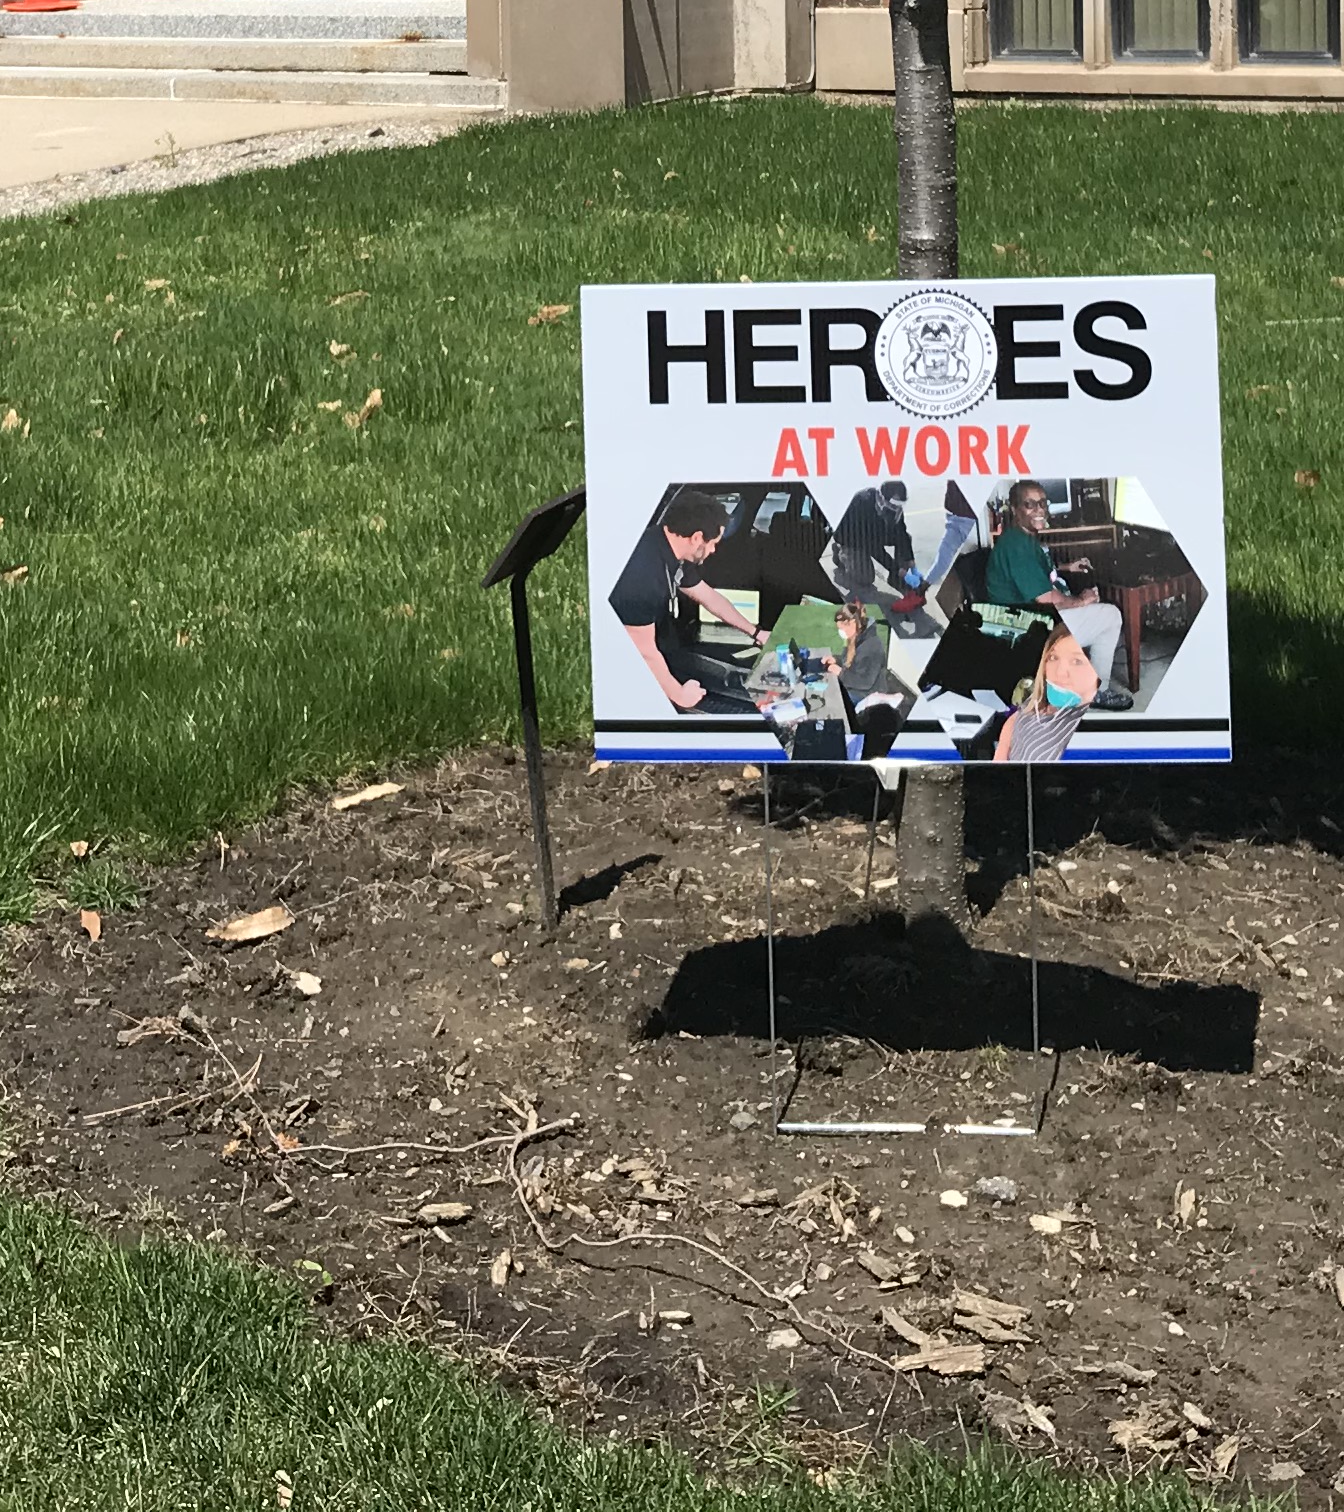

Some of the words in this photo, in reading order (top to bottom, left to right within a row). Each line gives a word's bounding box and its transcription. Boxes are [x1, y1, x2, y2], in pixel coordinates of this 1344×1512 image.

[896, 301, 918, 319] STATE
[920, 297, 932, 305] OF
[935, 296, 975, 318] MICHIGAN
[883, 370, 927, 411] DEPARTMENT
[929, 404, 942, 412] OF
[944, 369, 990, 411] CORRECTIONS
[771, 427, 835, 477] AT
[855, 424, 1031, 477] WORK
